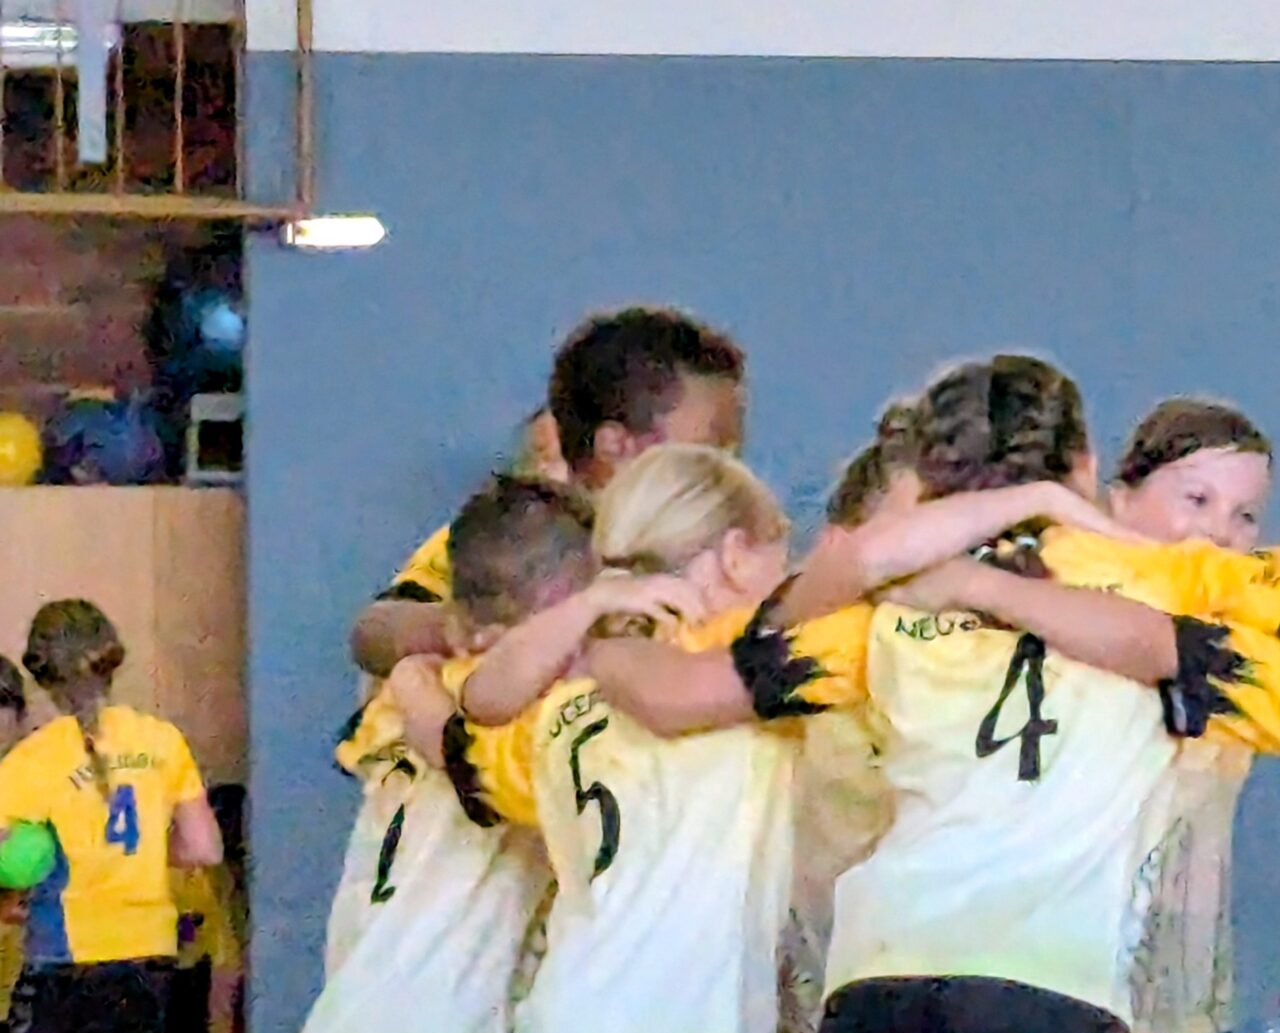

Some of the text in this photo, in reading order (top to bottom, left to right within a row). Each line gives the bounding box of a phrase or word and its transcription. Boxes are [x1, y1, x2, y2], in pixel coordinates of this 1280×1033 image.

[976, 632, 1058, 782] 4
[105, 784, 140, 856] 4
[569, 715, 621, 883] 5
